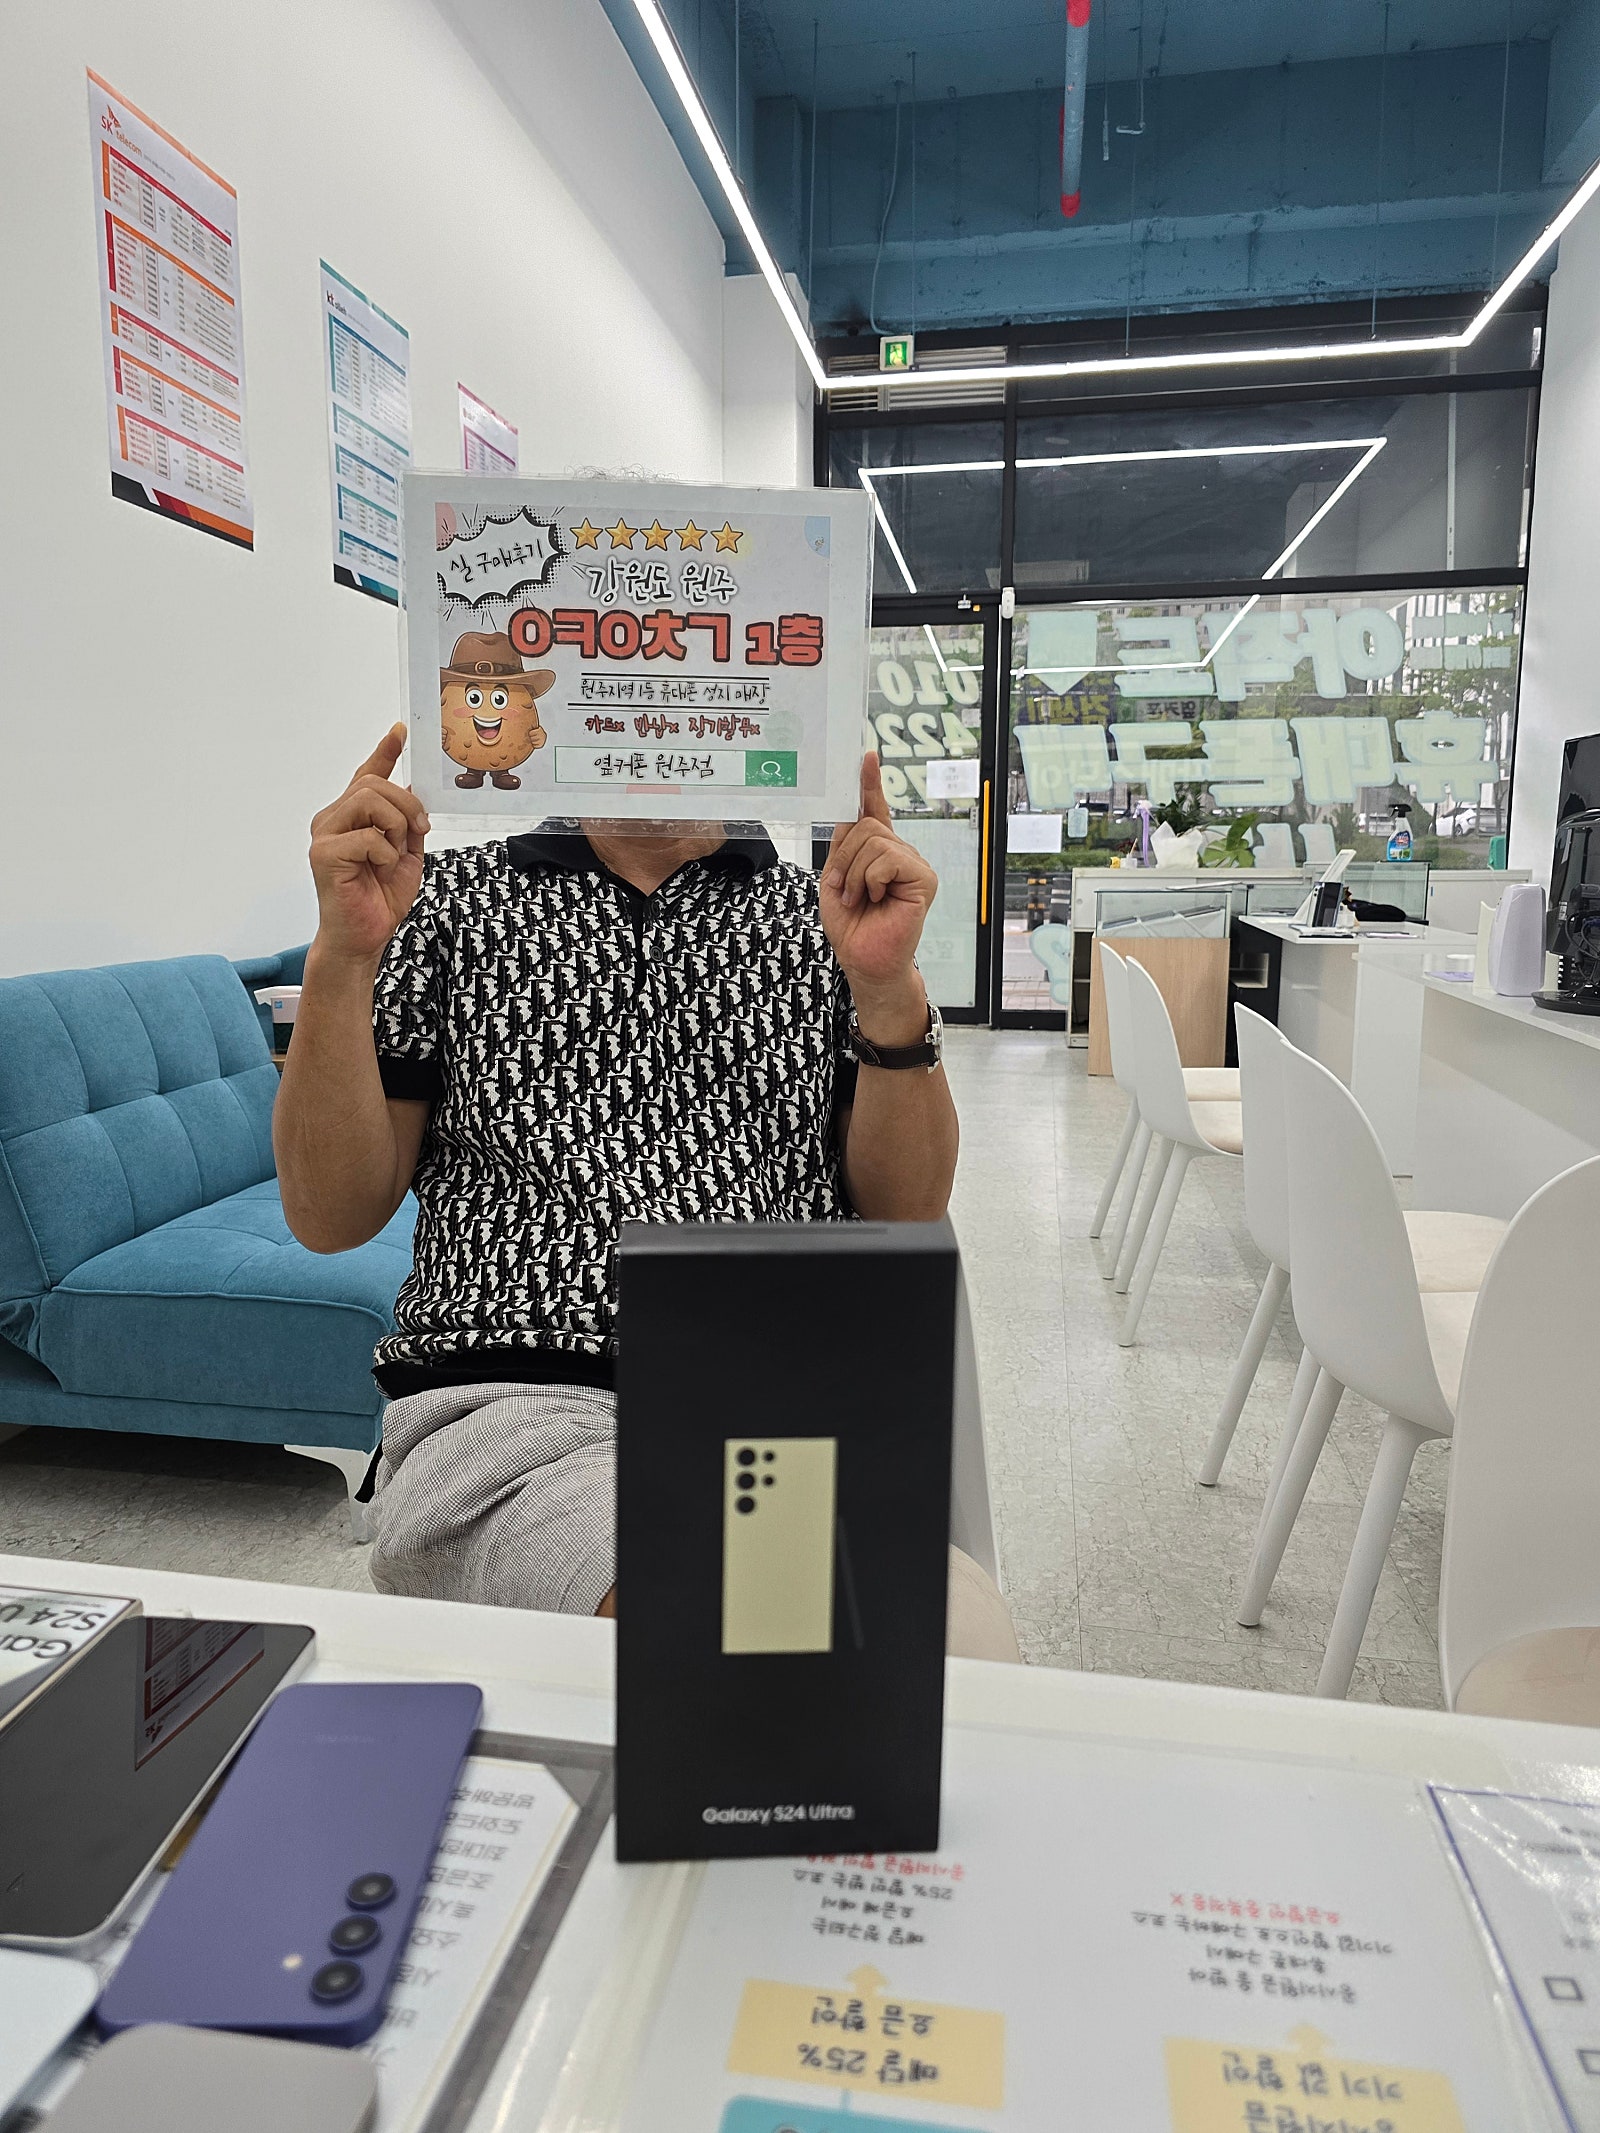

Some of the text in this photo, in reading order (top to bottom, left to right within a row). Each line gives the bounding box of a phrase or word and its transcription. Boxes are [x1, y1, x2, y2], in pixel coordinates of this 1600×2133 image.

[101, 115, 143, 157] SK telecom
[450, 539, 544, 583] 실 구매후기
[589, 557, 737, 603] 강원도 원주
[744, 612, 824, 667] 1층
[660, 681, 697, 703] 휴대폰
[703, 684, 730, 701] 성지
[735, 684, 770, 704] 매장
[594, 753, 715, 779] 옆커폰 원주점
[26, 1607, 106, 1631] S24
[702, 1803, 856, 1827] Galaxy S24 Ultra
[870, 1876, 905, 1896] 할인
[912, 1883, 954, 1902] 25%
[810, 1995, 935, 2039] 요금 할인
[797, 2042, 939, 2085] 매달 25%
[1221, 2051, 1284, 2093] 할인
